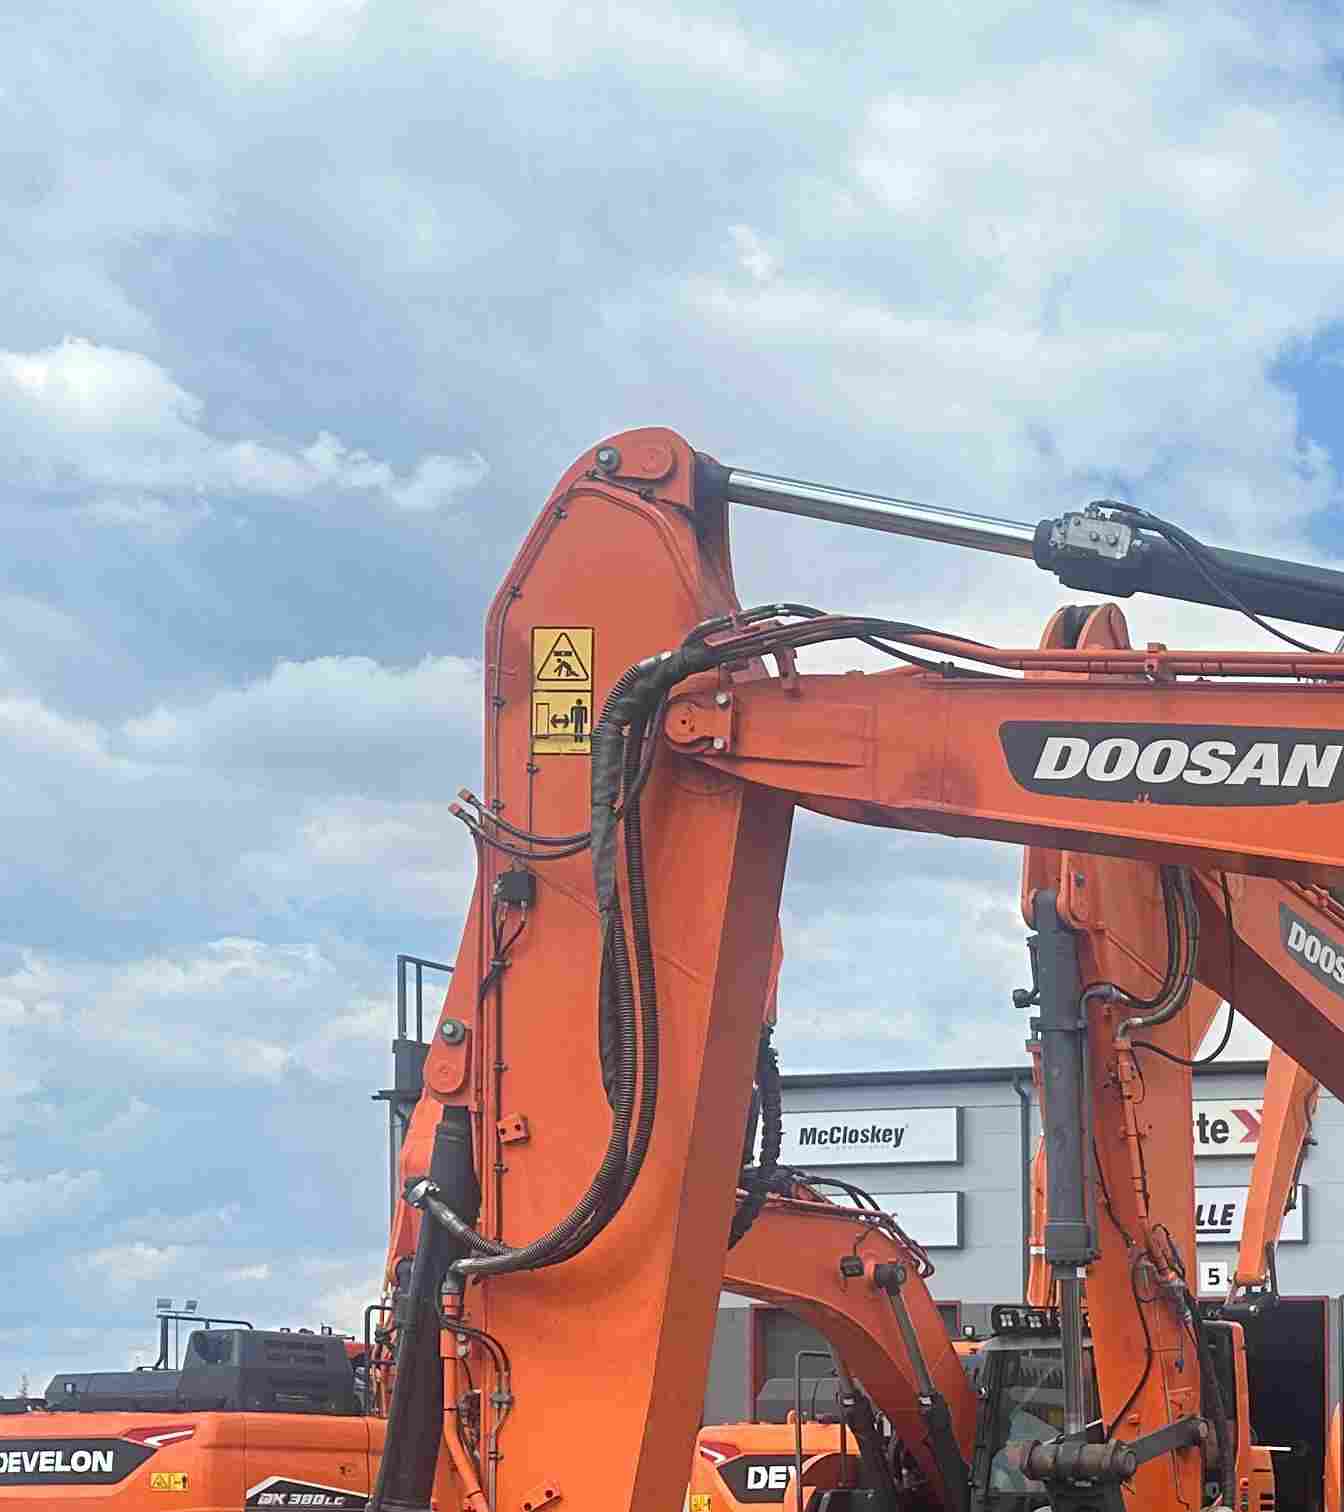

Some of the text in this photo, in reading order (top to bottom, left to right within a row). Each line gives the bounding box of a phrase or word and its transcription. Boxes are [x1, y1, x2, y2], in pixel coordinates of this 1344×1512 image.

[1032, 736, 1344, 788] DOOSAN
[798, 1125, 905, 1148] McCloskey
[1194, 1111, 1230, 1144] te
[1207, 1267, 1221, 1286] 5
[746, 1465, 797, 1489] DE
